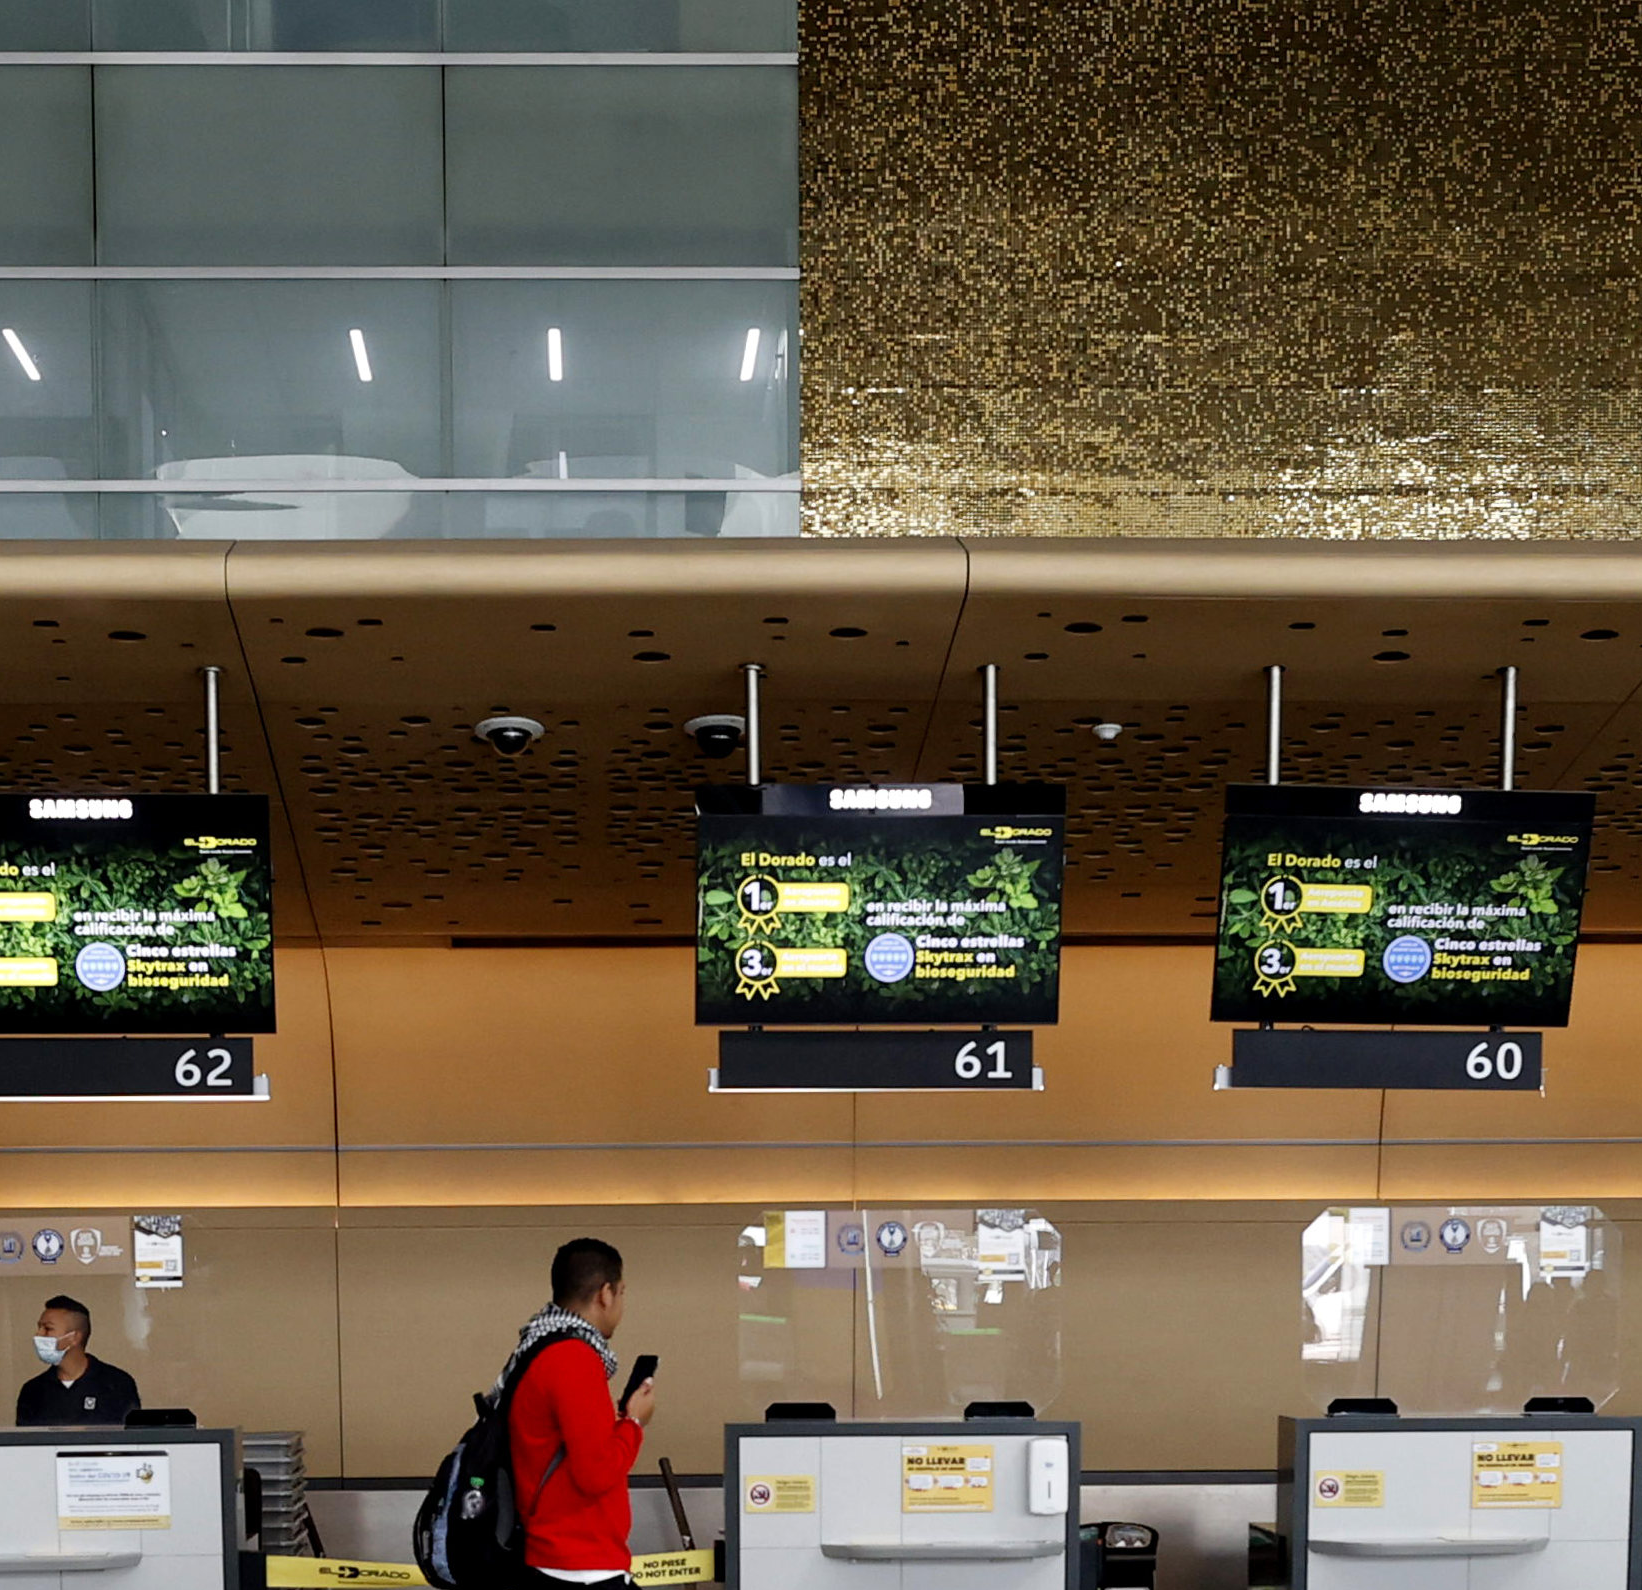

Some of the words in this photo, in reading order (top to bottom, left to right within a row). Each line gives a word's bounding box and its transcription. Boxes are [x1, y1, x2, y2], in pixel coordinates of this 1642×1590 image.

[28, 798, 134, 819] SAMSUNG
[1267, 854, 1283, 867] El
[1285, 854, 1342, 868] Dorado
[1344, 858, 1361, 869] es
[1363, 855, 1378, 869] el
[915, 964, 1016, 981] bioseguridad
[1431, 966, 1531, 983] bioseguridad
[128, 973, 230, 990] bioseguridad
[174, 1047, 234, 1087] 62
[954, 1041, 1014, 1079] 61
[1466, 1041, 1524, 1080] 60
[907, 1457, 923, 1465] NO
[926, 1457, 966, 1465] LLEVAR
[643, 1560, 659, 1569] NO
[645, 1569, 667, 1579] NOT
[669, 1566, 701, 1577] ENTER
